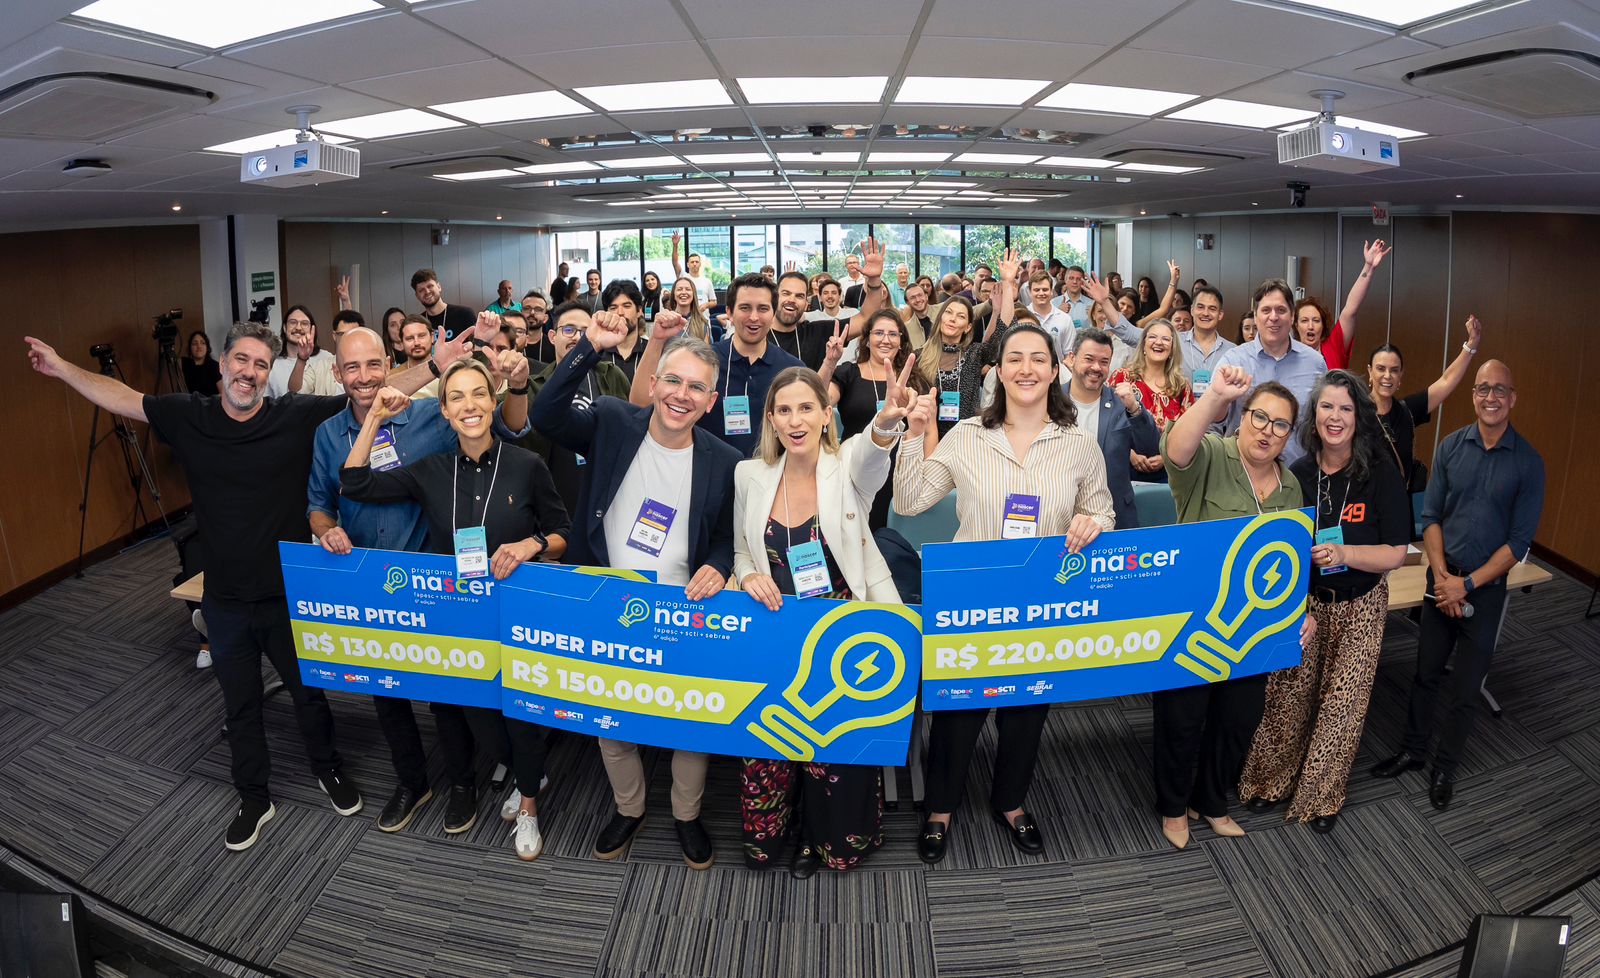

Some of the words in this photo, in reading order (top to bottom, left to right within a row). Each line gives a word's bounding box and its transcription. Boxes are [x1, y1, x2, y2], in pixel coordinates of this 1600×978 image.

[1341, 502, 1366, 522] 49
[1091, 549, 1179, 573] nascer
[1092, 546, 1137, 556] programa
[412, 575, 494, 596] nascer
[297, 600, 359, 621] SUPER
[366, 608, 426, 627] PITCH
[656, 601, 704, 610] programa
[936, 607, 1019, 627] SUPER
[1027, 600, 1098, 621] PITCH
[654, 608, 752, 632] nascer
[302, 632, 335, 655] R$
[340, 637, 485, 670] 130.000,00
[512, 626, 584, 653] SUPER
[592, 640, 662, 665] PITCH
[936, 643, 978, 670] R$
[988, 630, 1160, 665] 220.000,00
[512, 659, 549, 688] R$
[557, 669, 725, 713] 150.000,00
[1026, 683, 1053, 692] SEBRAE
[567, 711, 583, 719] SCTI
[594, 718, 620, 727] SEBRAE
